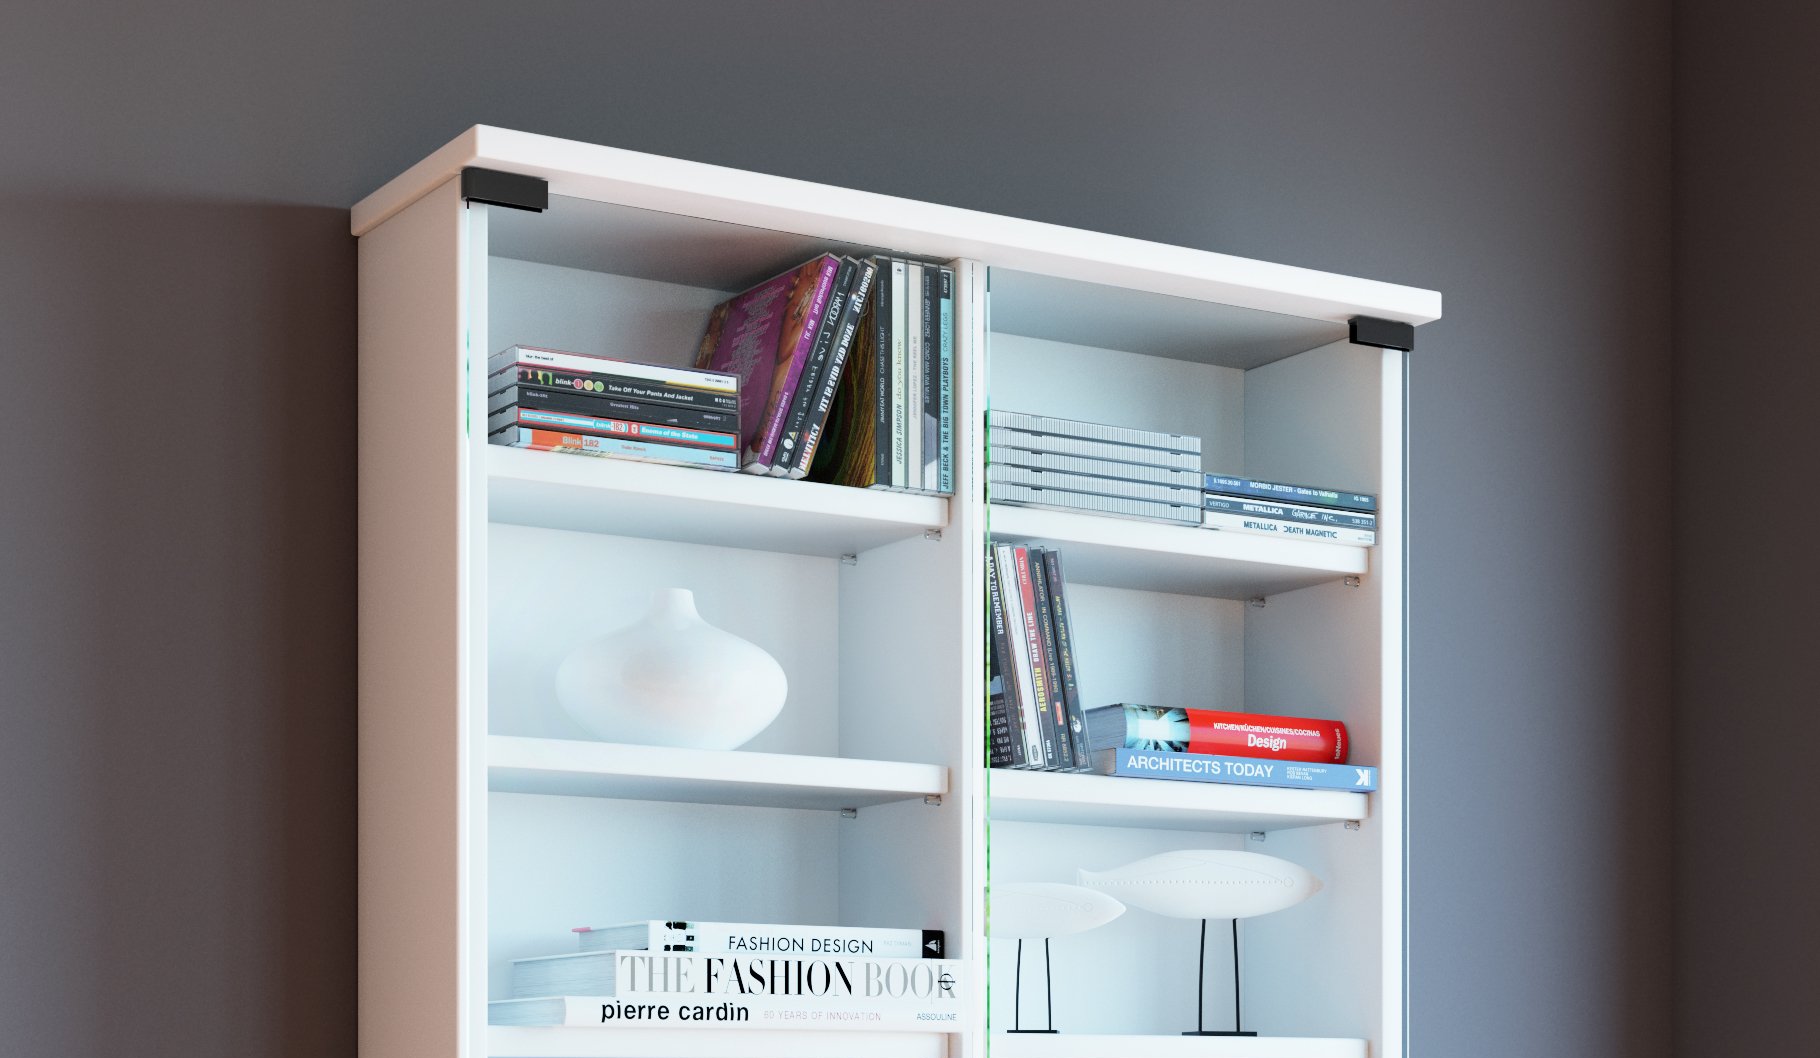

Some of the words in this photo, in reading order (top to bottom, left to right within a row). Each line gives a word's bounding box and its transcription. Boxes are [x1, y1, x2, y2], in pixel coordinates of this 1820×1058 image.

[608, 384, 621, 392] Take
[622, 386, 631, 394] Off
[633, 387, 645, 395] Your
[646, 389, 662, 398] Pants
[663, 391, 674, 399] And
[675, 393, 693, 402] Jacket
[894, 386, 901, 399] do
[562, 435, 580, 445] Blink
[583, 438, 599, 447] 182
[641, 426, 661, 436] Enema
[671, 430, 680, 438] the
[681, 431, 698, 440] State
[1249, 481, 1271, 490] MORBID
[1272, 484, 1292, 493] JESTER
[1297, 488, 1311, 496] Gates
[1319, 491, 1337, 499] Valhalla
[1243, 504, 1283, 515] METALLICA
[1244, 521, 1278, 532] METALLICA
[1284, 525, 1304, 535] DEATH
[1306, 528, 1338, 538] MAGNETIC
[1017, 556, 1027, 584] COLUMBIA
[989, 580, 998, 590] TO
[991, 591, 1004, 634] REMEMBER
[1033, 562, 1045, 601] ANNIHILATOR
[1041, 614, 1052, 646] COMMAND
[1026, 611, 1035, 627] LINE
[1028, 629, 1037, 640] THE
[1030, 643, 1040, 661] DRAW
[1033, 667, 1047, 711] AEROSMITH
[1248, 734, 1286, 750] Design
[1127, 755, 1220, 774] ARCHITECTS
[1227, 762, 1274, 778] TODAY
[728, 936, 804, 952] FASHION
[812, 938, 873, 954] DESIGN
[620, 955, 695, 994] THE
[704, 957, 854, 997] FASHION
[865, 962, 956, 999] BOOK
[601, 1000, 670, 1022] pierre
[678, 1002, 749, 1021] cardin
[778, 1010, 808, 1020] YEARS
[811, 1012, 823, 1020] OF
[826, 1012, 881, 1021] INNOVATION
[916, 1013, 957, 1021] ASSOULINE
